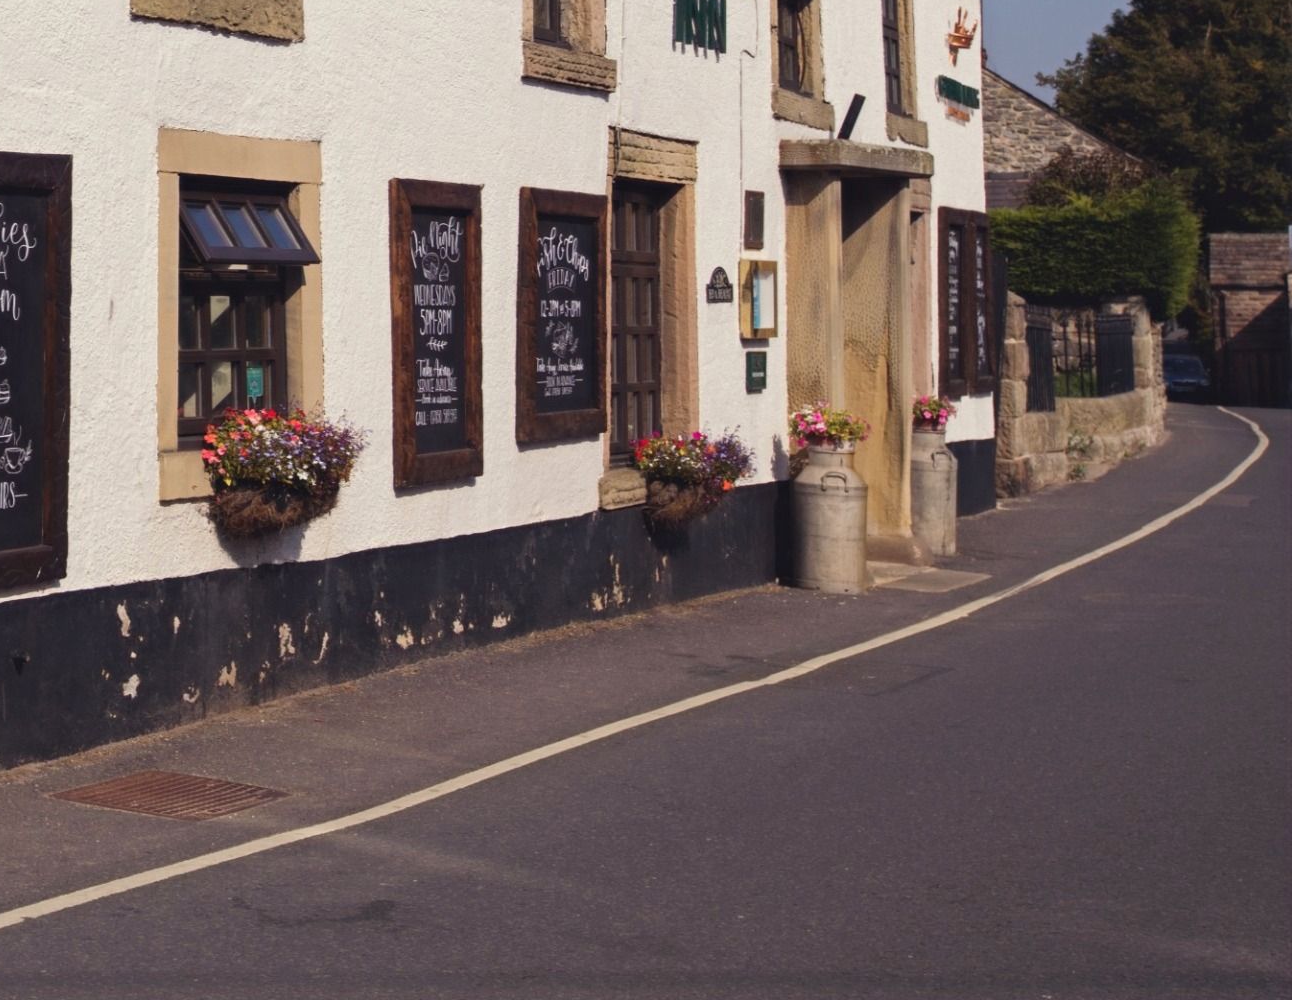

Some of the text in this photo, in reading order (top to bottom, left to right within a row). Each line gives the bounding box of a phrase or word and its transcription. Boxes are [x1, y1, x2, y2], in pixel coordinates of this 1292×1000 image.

[410, 216, 464, 269] Pie Night
[419, 308, 453, 336] 5PM-8PM
